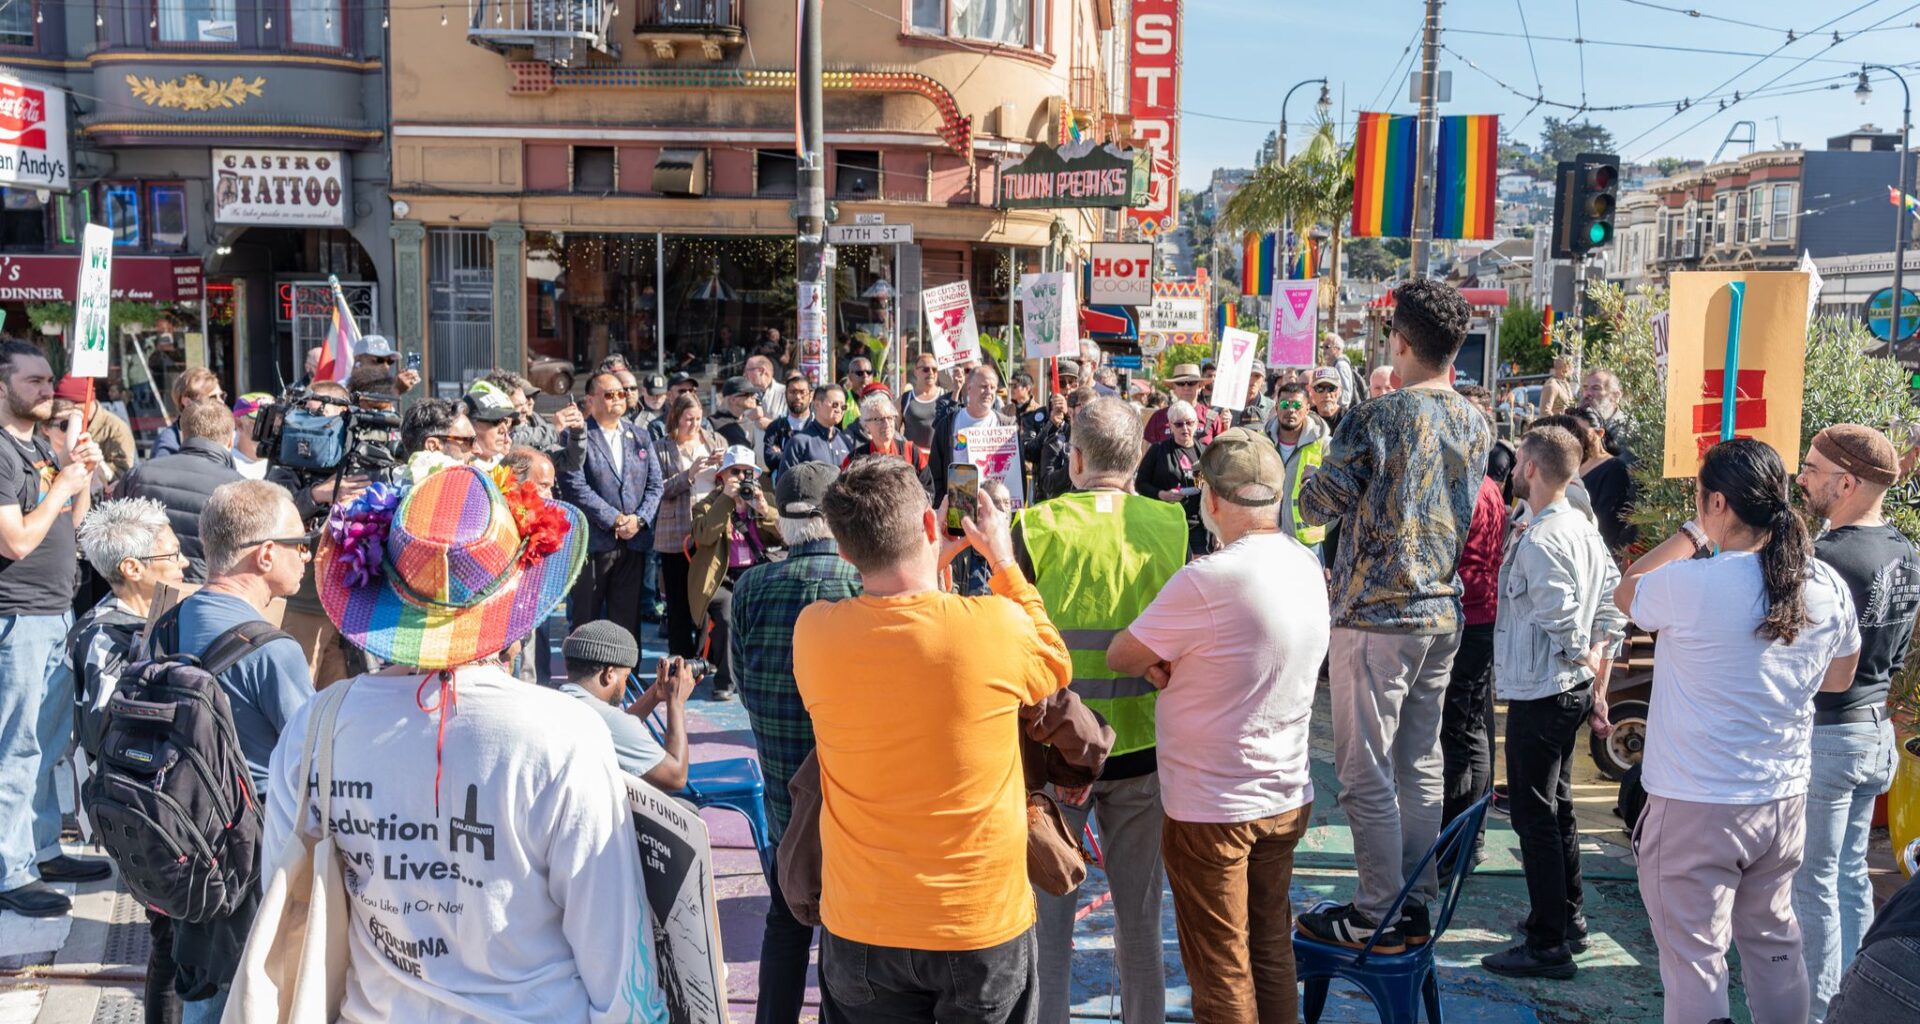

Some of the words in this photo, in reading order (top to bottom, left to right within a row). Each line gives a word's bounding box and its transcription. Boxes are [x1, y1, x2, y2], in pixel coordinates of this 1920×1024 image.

[18, 150, 65, 183] Andy's
[223, 155, 331, 171] CASTRO
[239, 175, 342, 207] TATTOO
[1003, 173, 1053, 199] TWIN
[1056, 168, 1127, 197] PEAKS
[841, 228, 871, 240] 17TH
[882, 228, 897, 240] ST
[0, 256, 21, 281] 's
[1093, 257, 1150, 278] HOT
[0, 288, 64, 300] DINNER
[937, 286, 956, 296] CUTS
[957, 283, 967, 291] TO
[1092, 279, 1150, 293] COOKIE
[938, 291, 969, 303] FUNDING
[1157, 310, 1198, 320] WATANABE
[968, 428, 980, 436] NO
[1005, 427, 1015, 435] TO
[982, 436, 1016, 444] FUNDING
[626, 785, 647, 806] HIV
[384, 853, 483, 888] Lives...
[646, 855, 666, 875] LIFE
[380, 898, 400, 914] Like
[403, 901, 412, 915] It
[414, 899, 435, 912] Or
